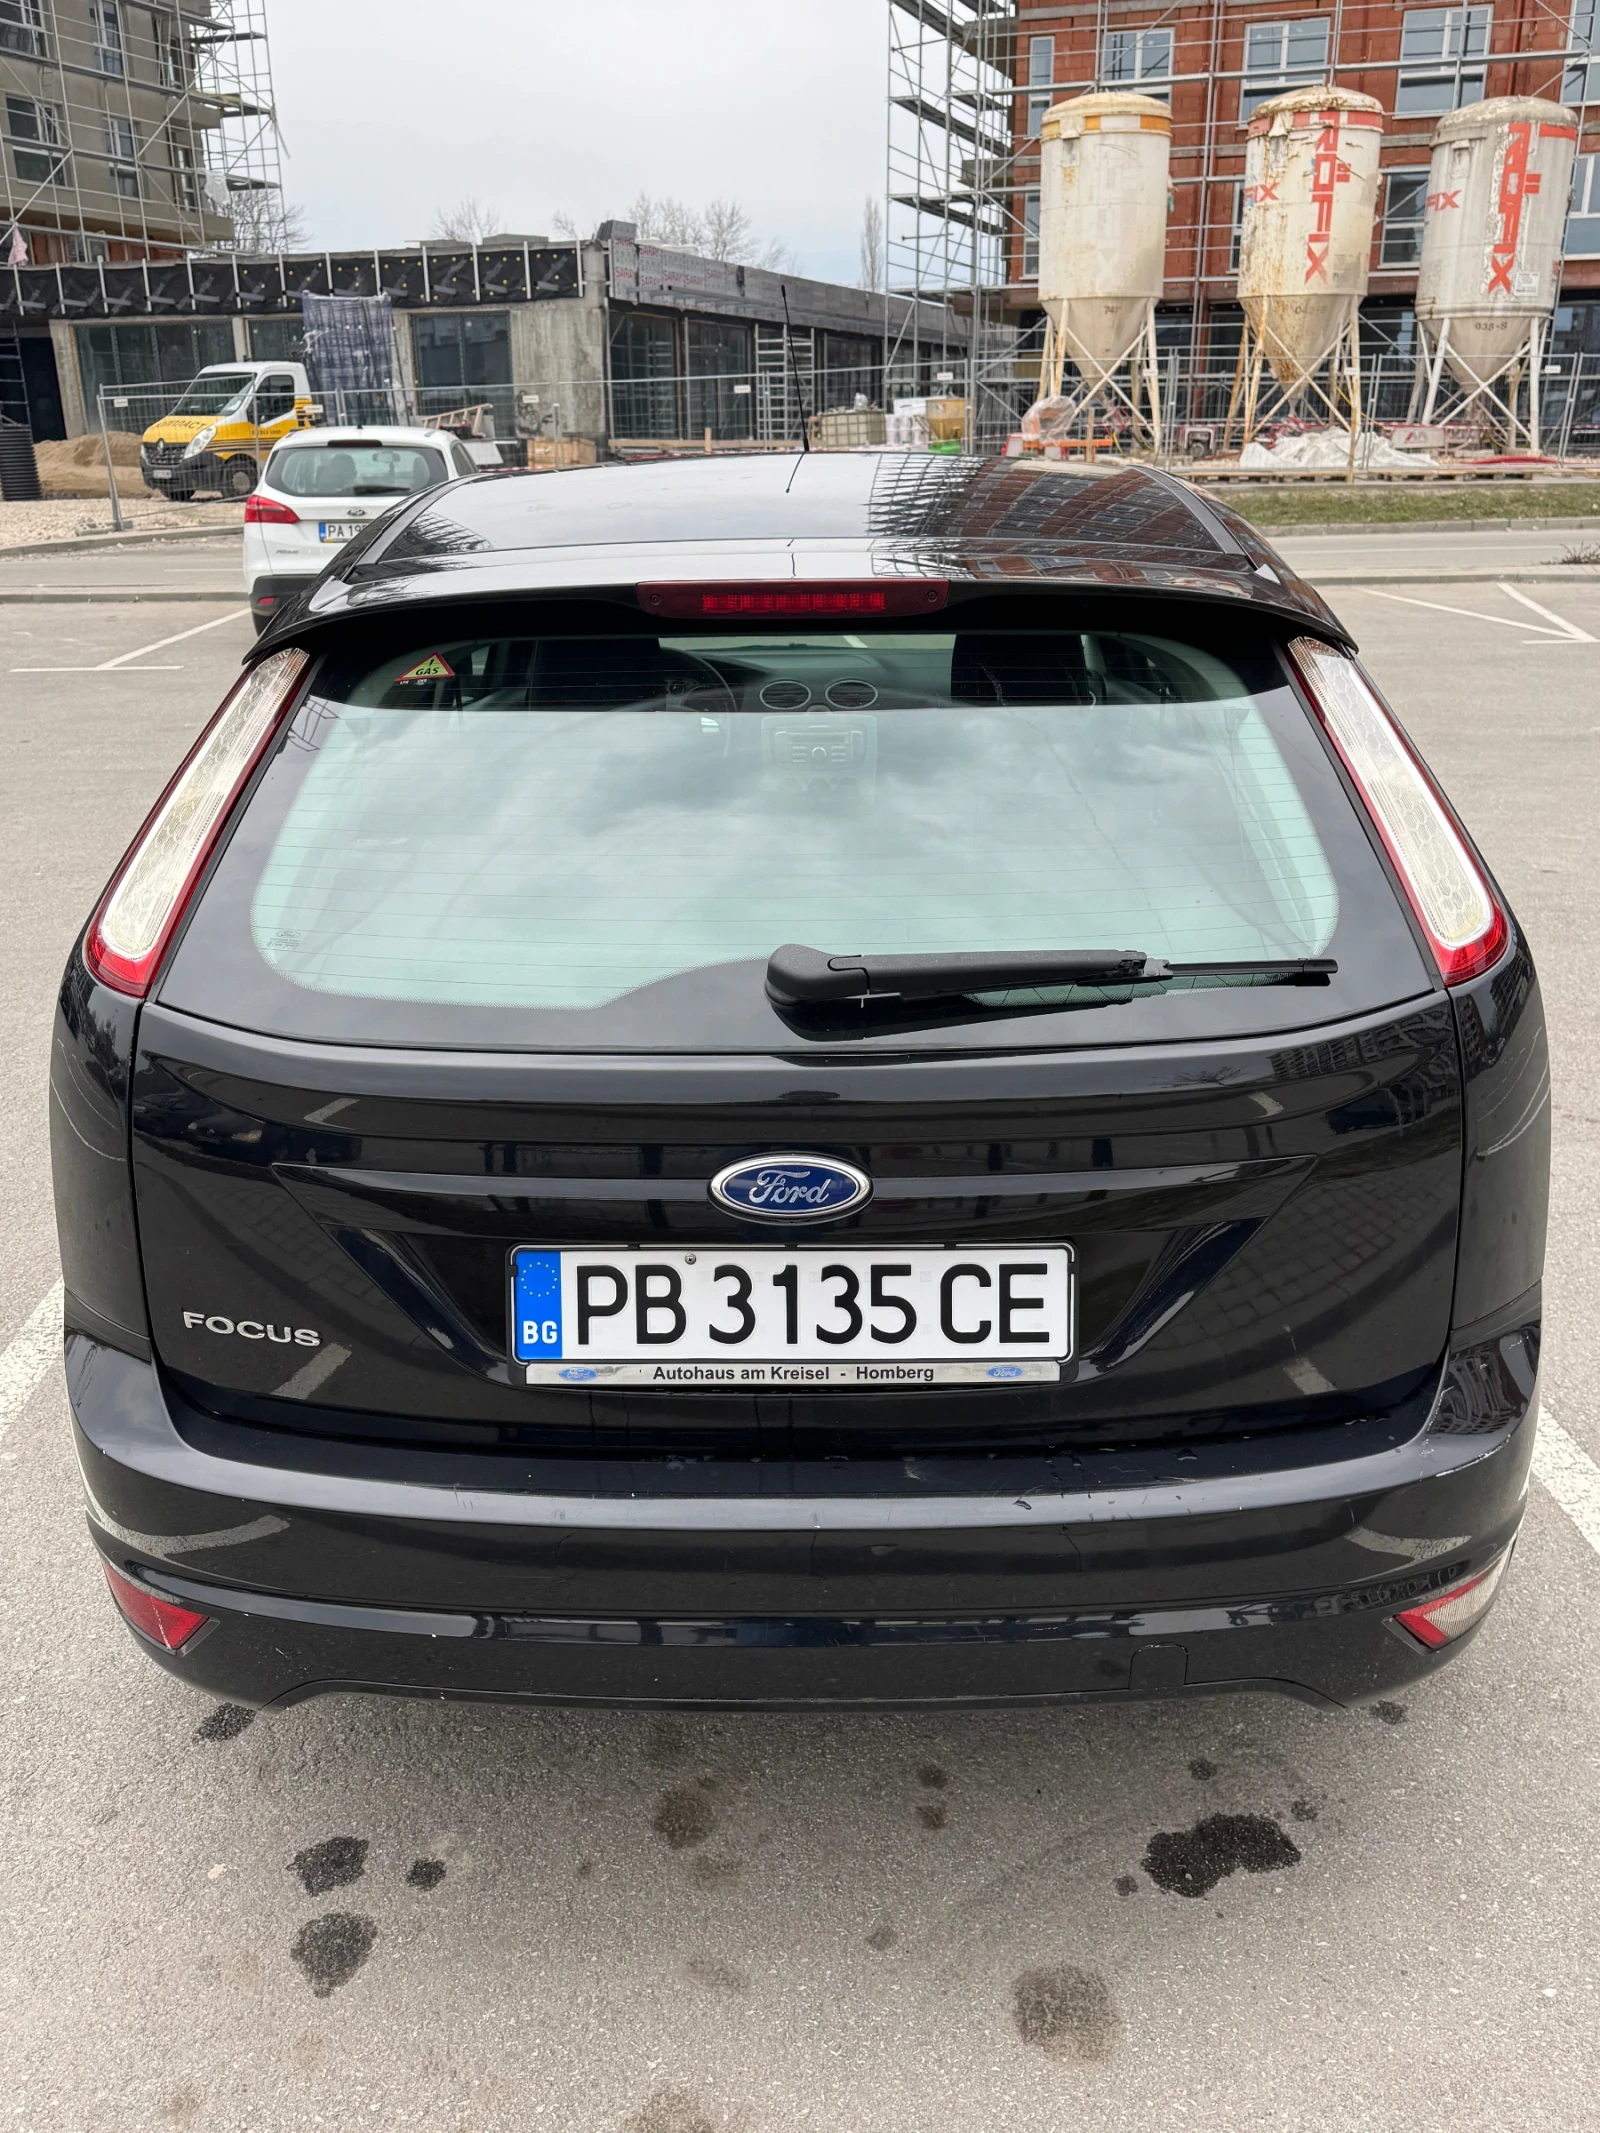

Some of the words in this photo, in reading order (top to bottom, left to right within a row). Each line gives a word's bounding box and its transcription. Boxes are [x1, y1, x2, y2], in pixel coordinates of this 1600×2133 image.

[328, 525, 344, 537] PA
[415, 667, 439, 676] GAS
[749, 1169, 832, 1203] Ford
[577, 1264, 687, 1346] PB
[709, 1264, 917, 1345] 3135
[940, 1263, 1050, 1344] CE
[183, 1311, 322, 1347] FOCUS
[522, 1320, 558, 1345] BG
[653, 1366, 735, 1381] Autohaus
[740, 1368, 766, 1380] am
[771, 1365, 829, 1380] Kreisel
[856, 1365, 934, 1382] Homberg
